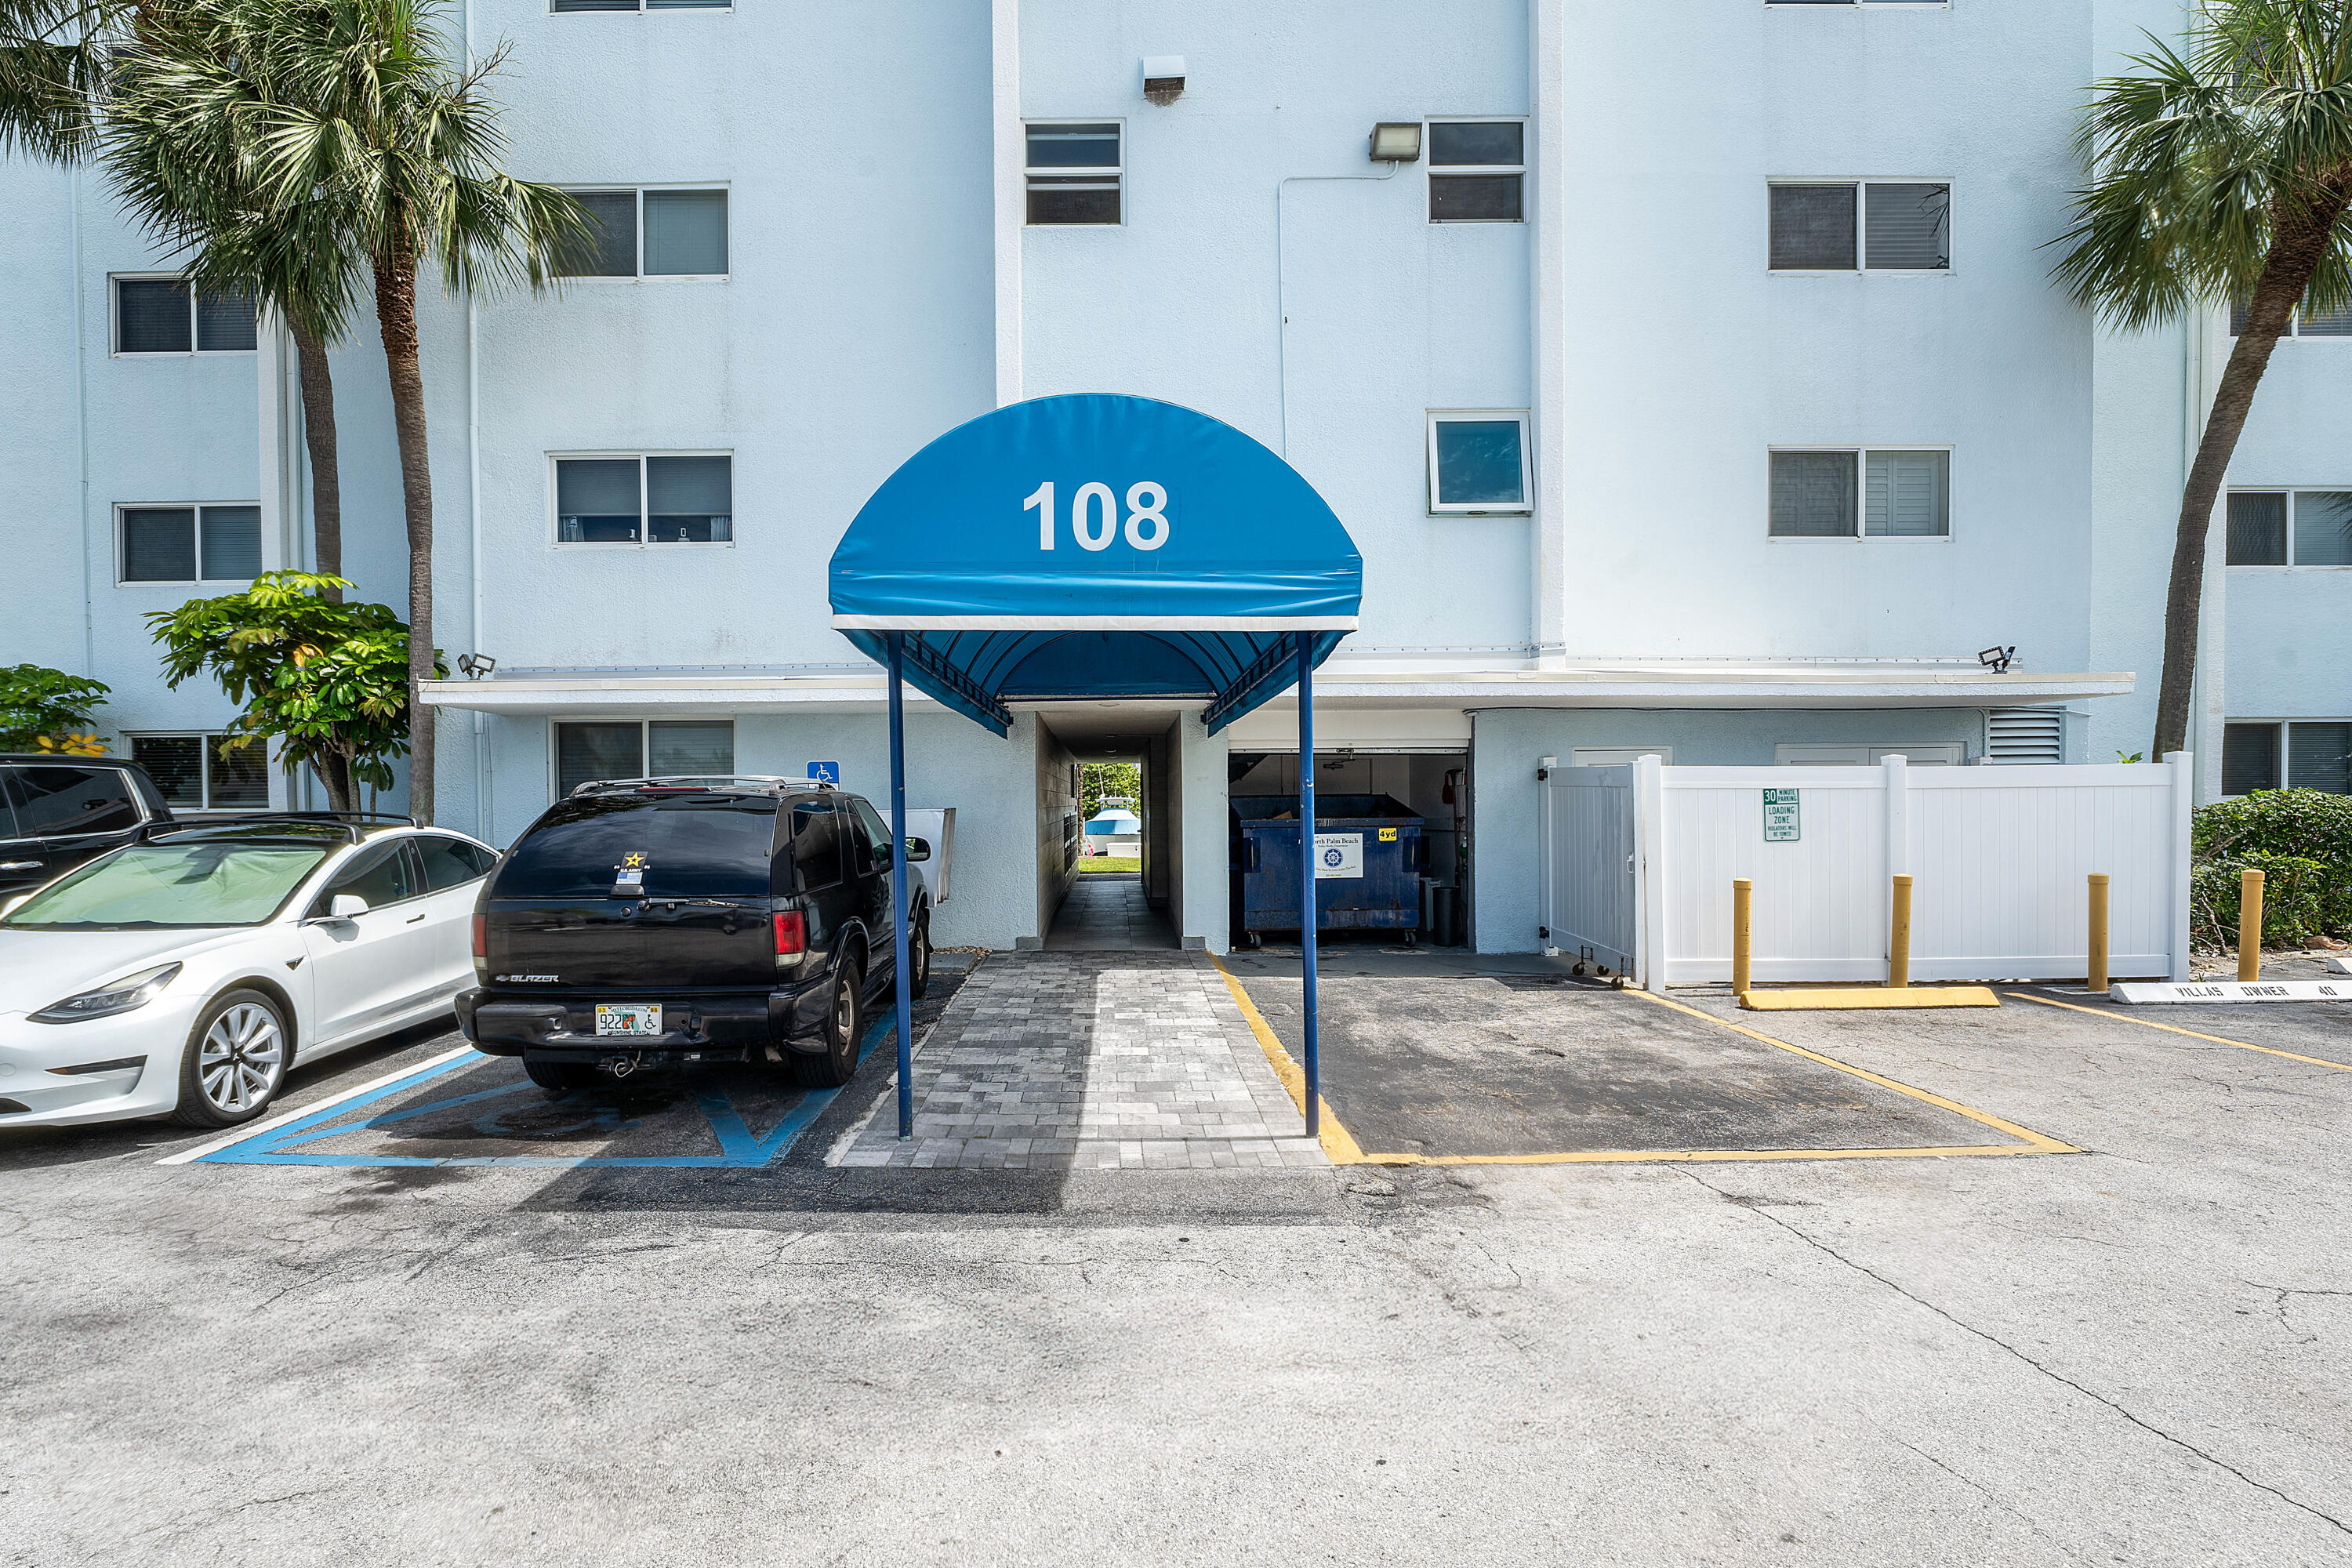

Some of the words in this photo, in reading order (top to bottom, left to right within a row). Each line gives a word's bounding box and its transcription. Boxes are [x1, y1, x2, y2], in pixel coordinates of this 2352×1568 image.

[1023, 481, 1171, 552] 108
[1764, 789, 1777, 802] 30
[1774, 815, 1790, 824] ZONE
[2174, 986, 2224, 997] VILLAS
[2240, 985, 2290, 996] OWNER
[2318, 985, 2339, 996] 40
